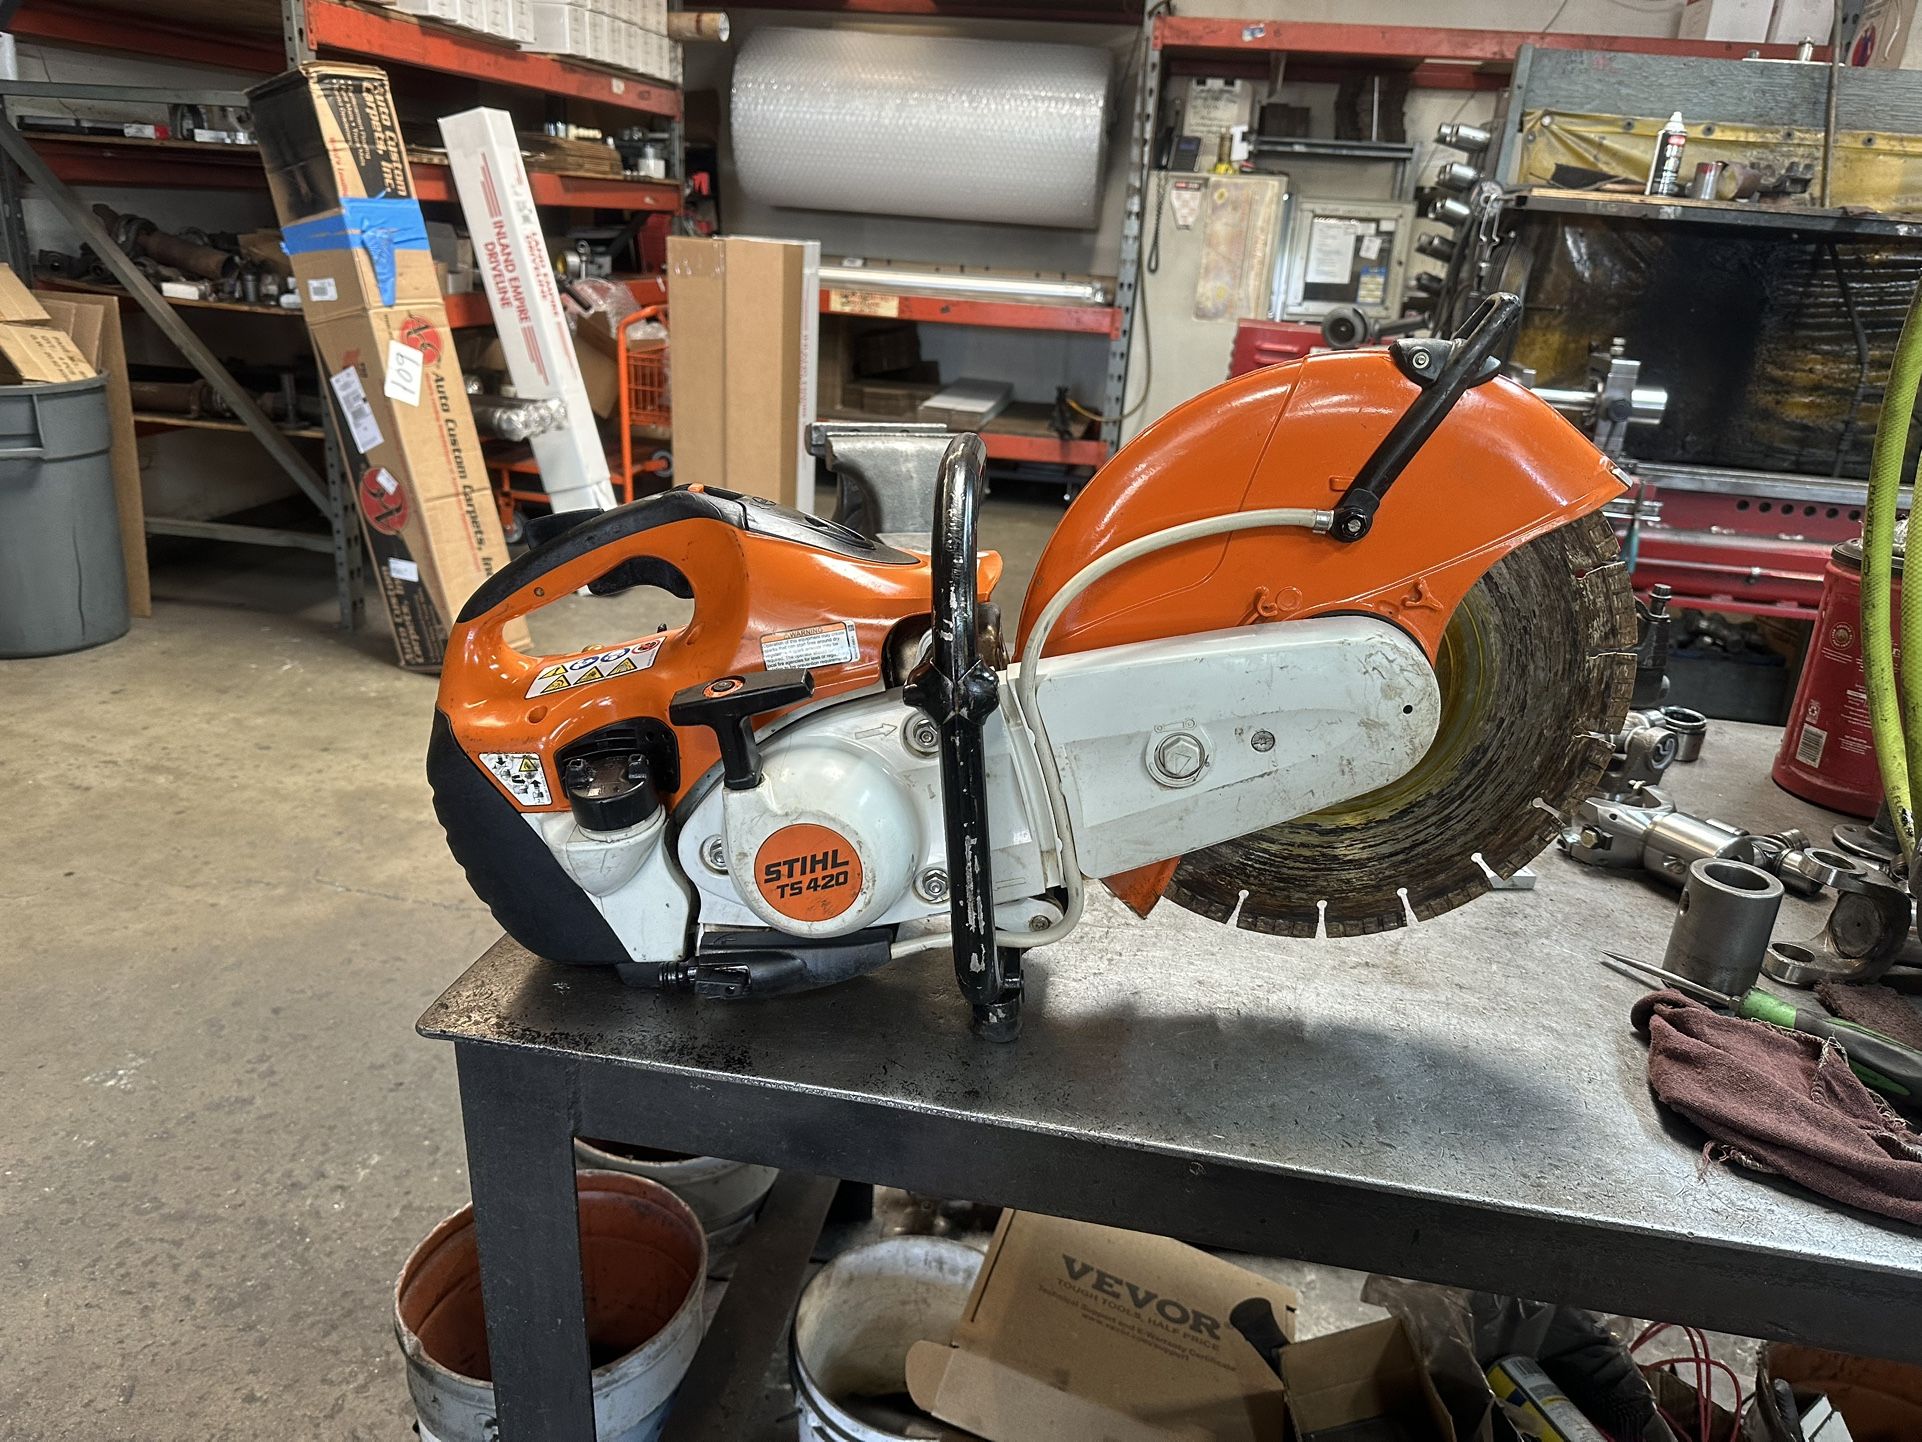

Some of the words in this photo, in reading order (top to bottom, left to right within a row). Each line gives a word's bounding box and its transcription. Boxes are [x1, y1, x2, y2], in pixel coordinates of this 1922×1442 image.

[363, 83, 386, 154] Carpets,
[381, 161, 394, 191] Inc.
[385, 131, 408, 196] Custom
[484, 242, 512, 309] DRIVELINE
[493, 221, 516, 273] INLAND
[509, 277, 531, 322] EMPIRE
[433, 373, 450, 412] Auto
[446, 419, 467, 479] Custom
[463, 485, 486, 550] Carpets,
[382, 567, 402, 622] Custom
[398, 628, 412, 663] Auto
[401, 602, 424, 663] Carpets,
[789, 627, 823, 638] WARNING
[798, 660, 819, 668] prevention
[764, 849, 849, 884] STIHL
[776, 880, 803, 899] TS
[806, 871, 848, 892] 420
[1057, 1278, 1098, 1300] TOUGH
[1103, 1298, 1142, 1323] TOOLS,
[1148, 1316, 1180, 1334] HALF
[1182, 1331, 1220, 1352] PRICE
[1062, 1253, 1221, 1341] VEVOR
[1080, 1303, 1117, 1324] Support
[1118, 1320, 1135, 1331] and
